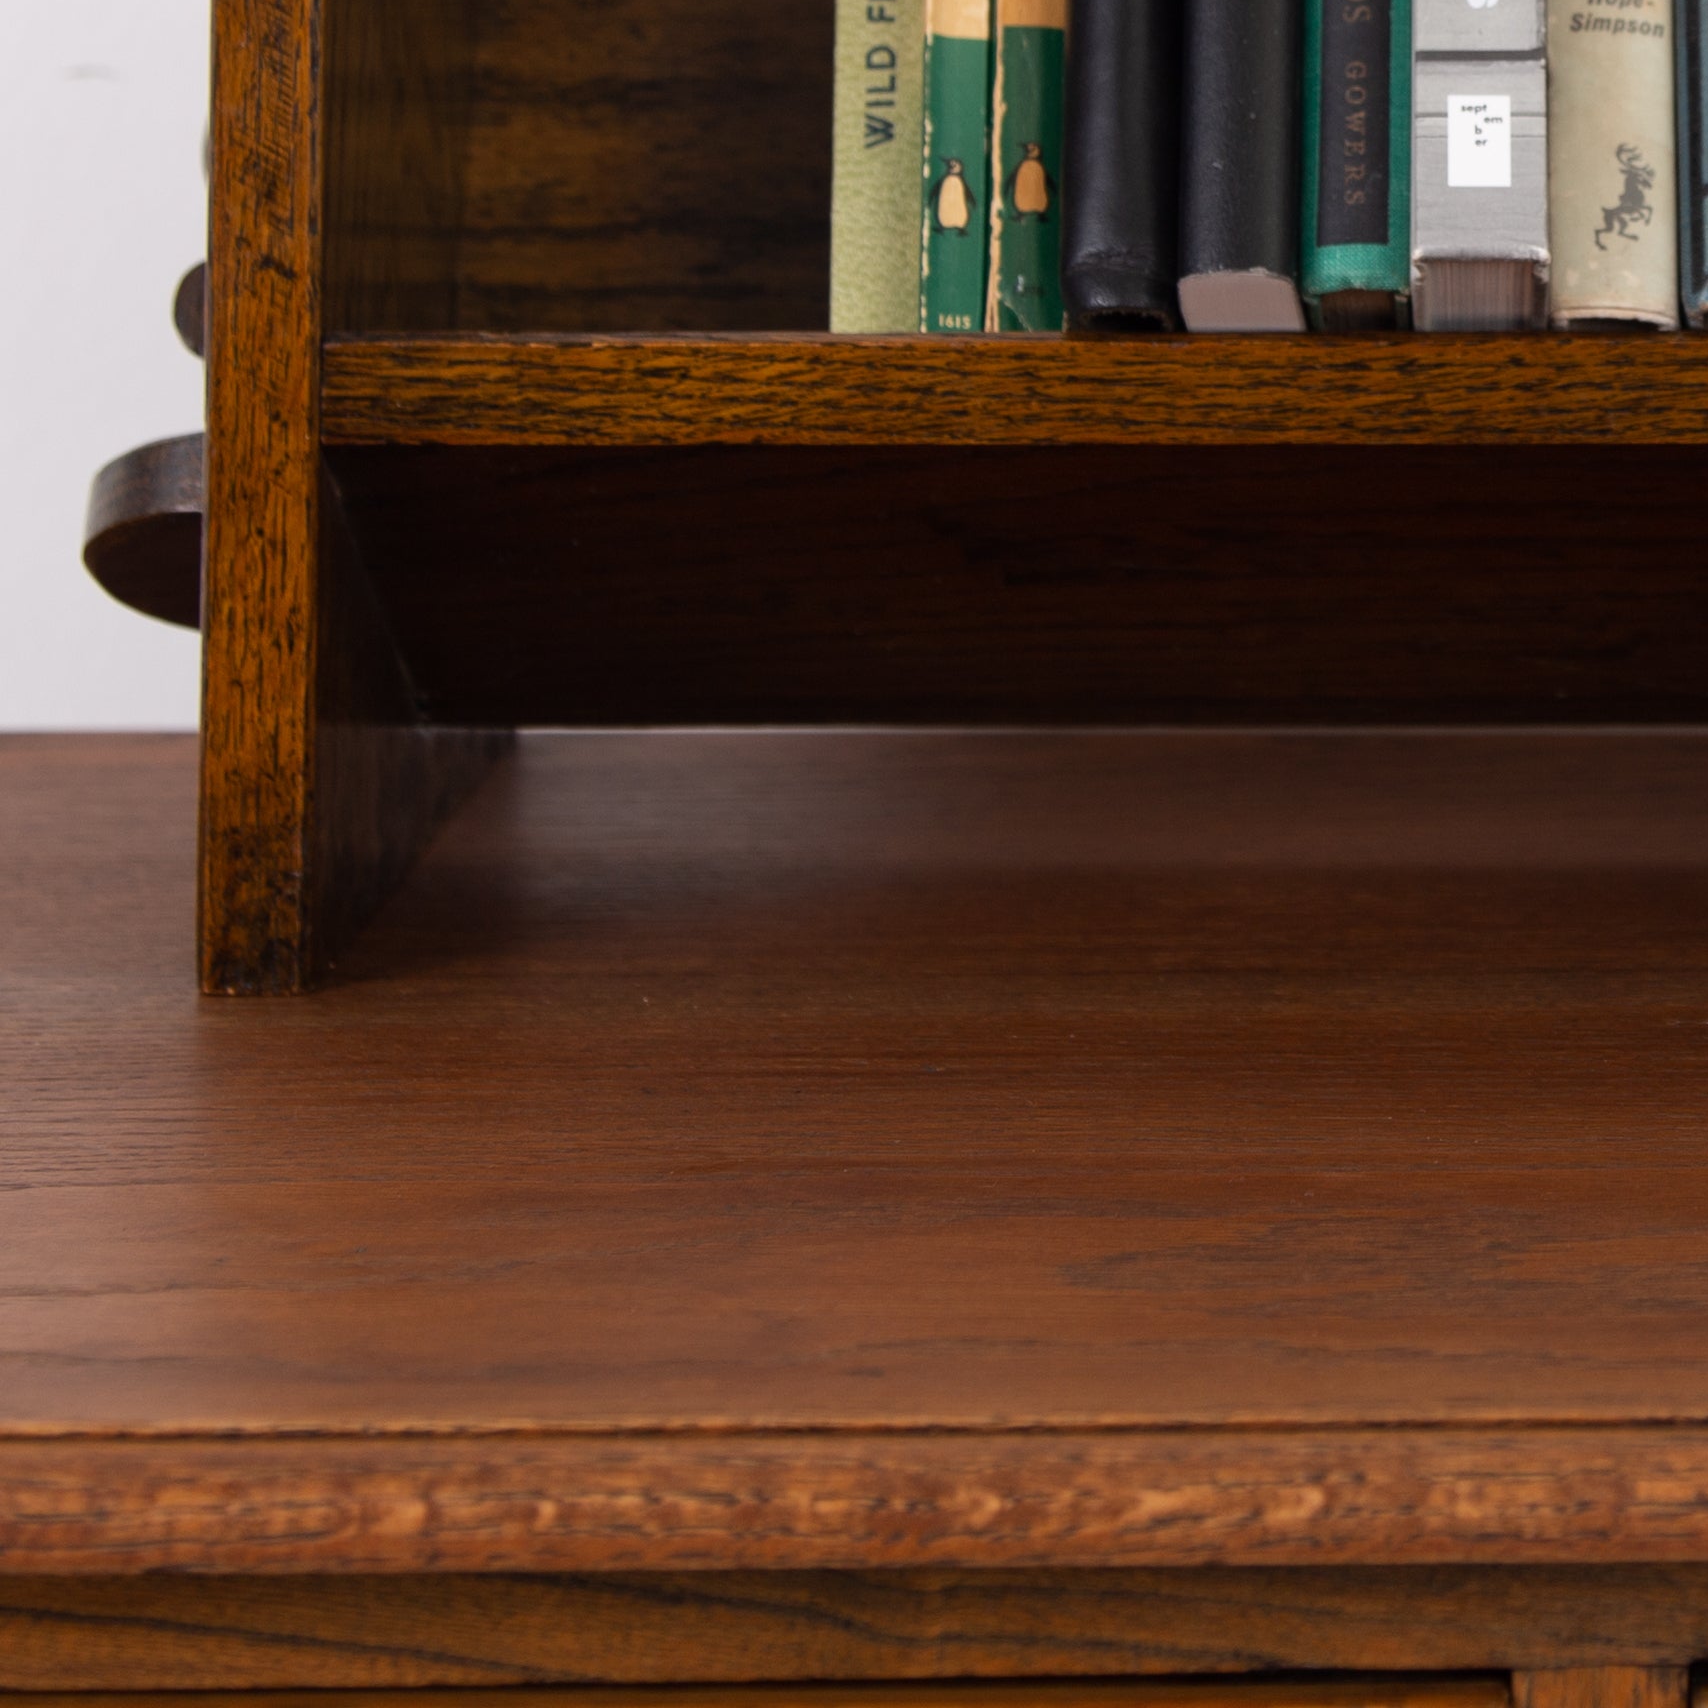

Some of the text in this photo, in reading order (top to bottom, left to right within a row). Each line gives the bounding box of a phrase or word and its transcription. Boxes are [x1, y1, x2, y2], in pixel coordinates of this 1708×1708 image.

[1569, 12, 1665, 38] Simpson
[863, 44, 897, 150] WILD
[1342, 59, 1369, 208] GOWERS
